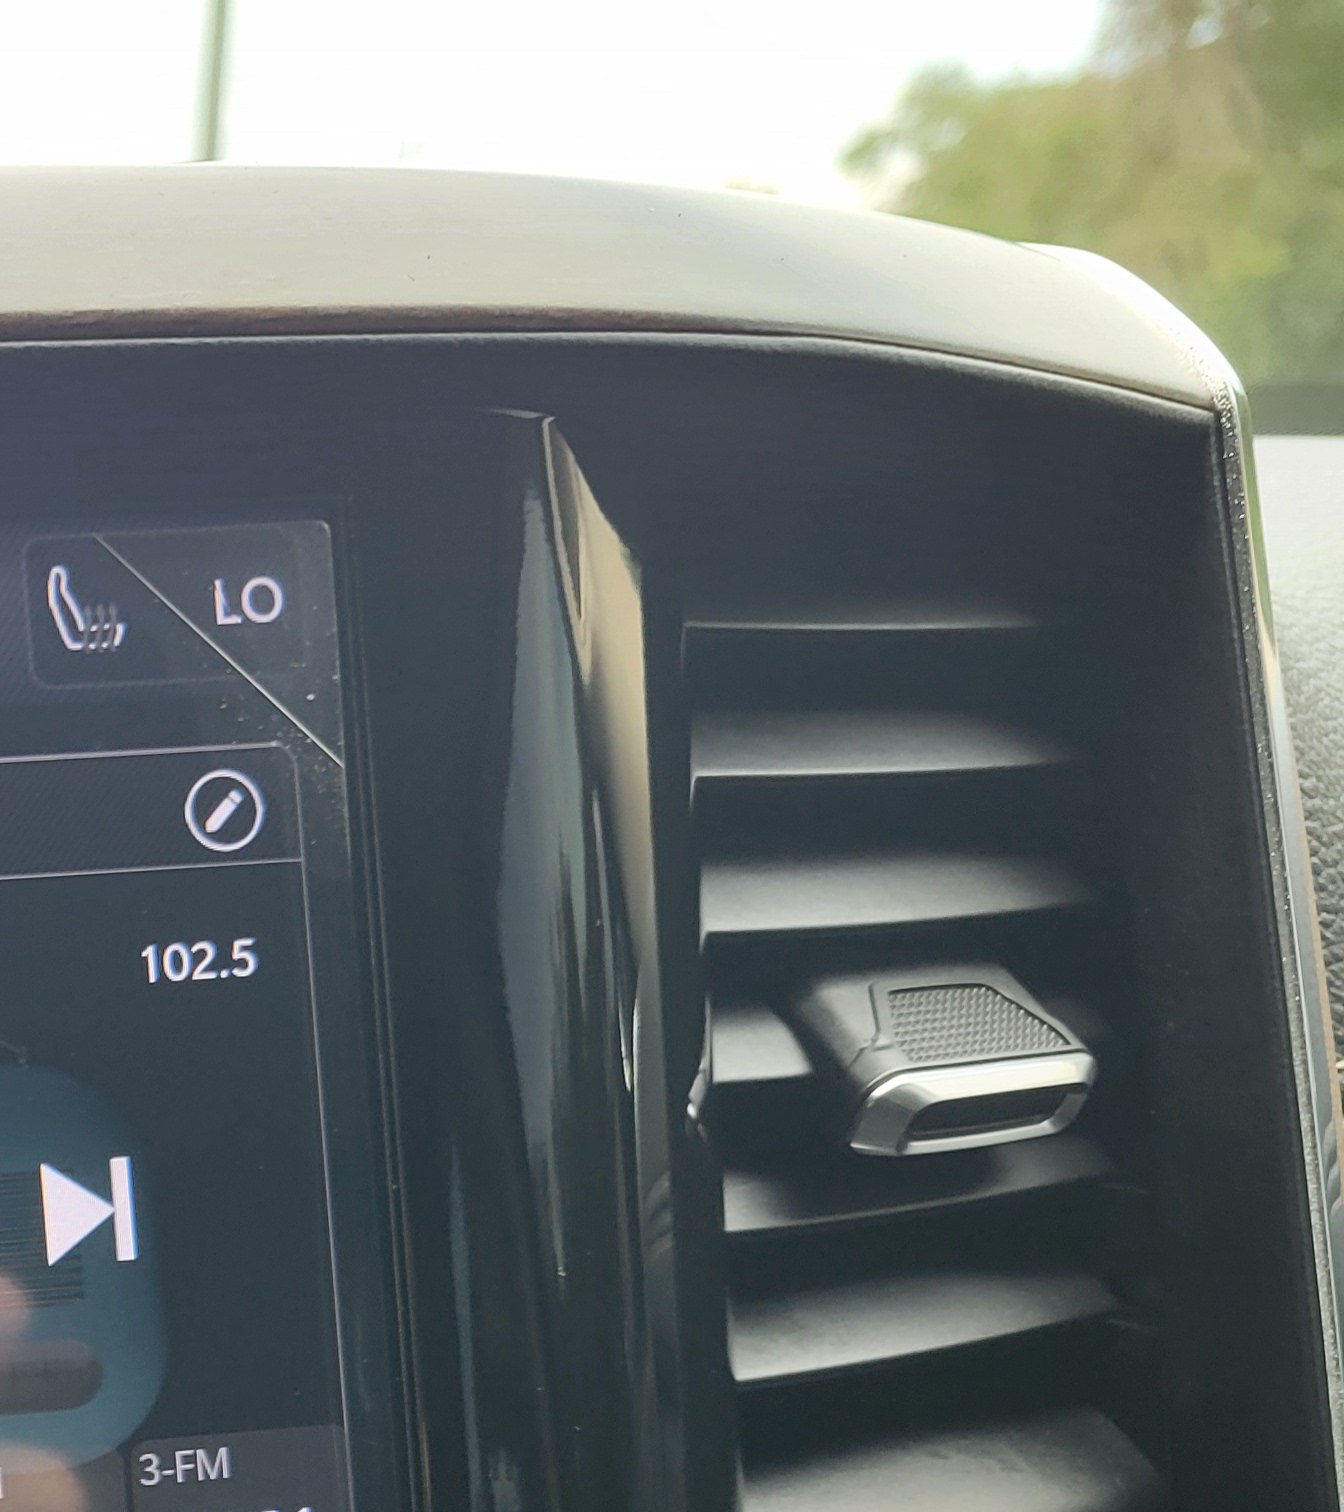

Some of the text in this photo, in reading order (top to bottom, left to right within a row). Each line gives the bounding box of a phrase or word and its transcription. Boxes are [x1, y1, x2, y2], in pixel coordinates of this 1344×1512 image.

[214, 575, 284, 627] LO
[139, 940, 260, 985] 102.5
[137, 1446, 232, 1487] 3-FM
